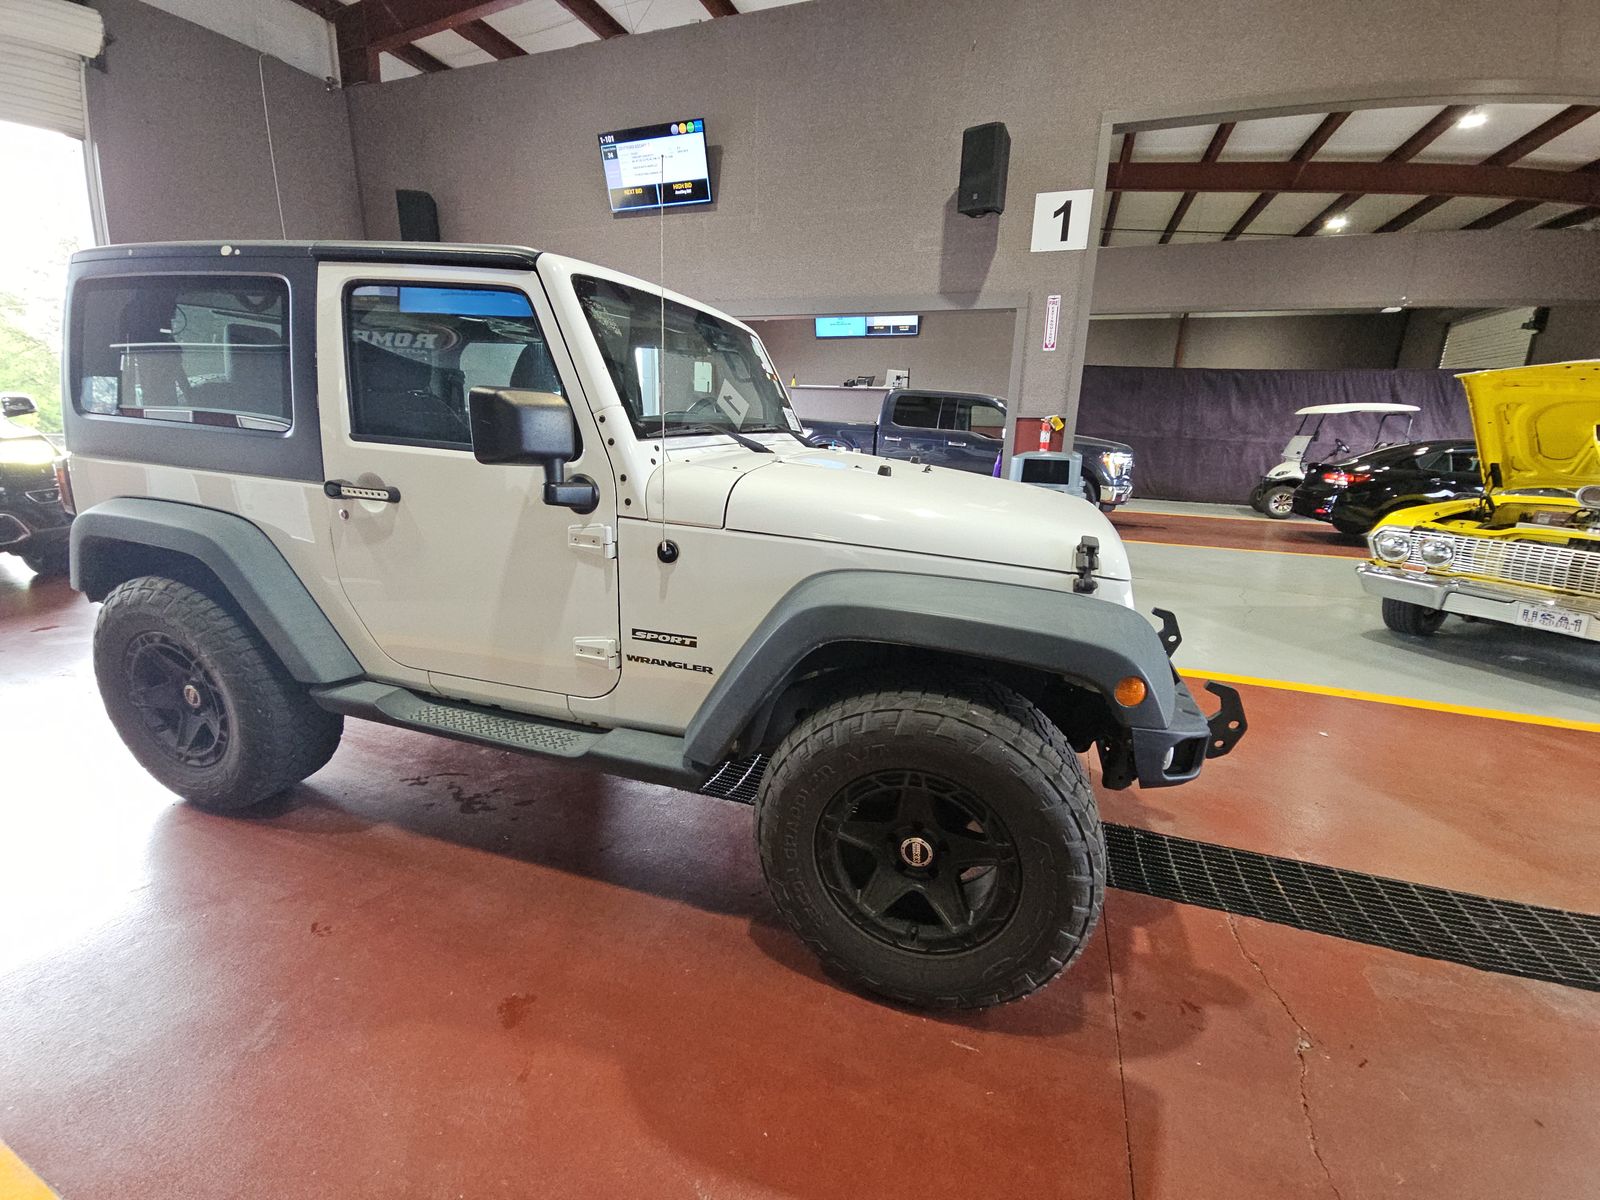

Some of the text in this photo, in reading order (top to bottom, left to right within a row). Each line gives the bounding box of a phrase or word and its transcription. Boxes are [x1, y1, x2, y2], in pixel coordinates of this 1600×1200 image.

[599, 135, 615, 144] 1-101
[1053, 199, 1072, 242] 1
[723, 394, 741, 416] 1
[634, 630, 693, 646] SPORT
[626, 654, 714, 675] WRANGLER
